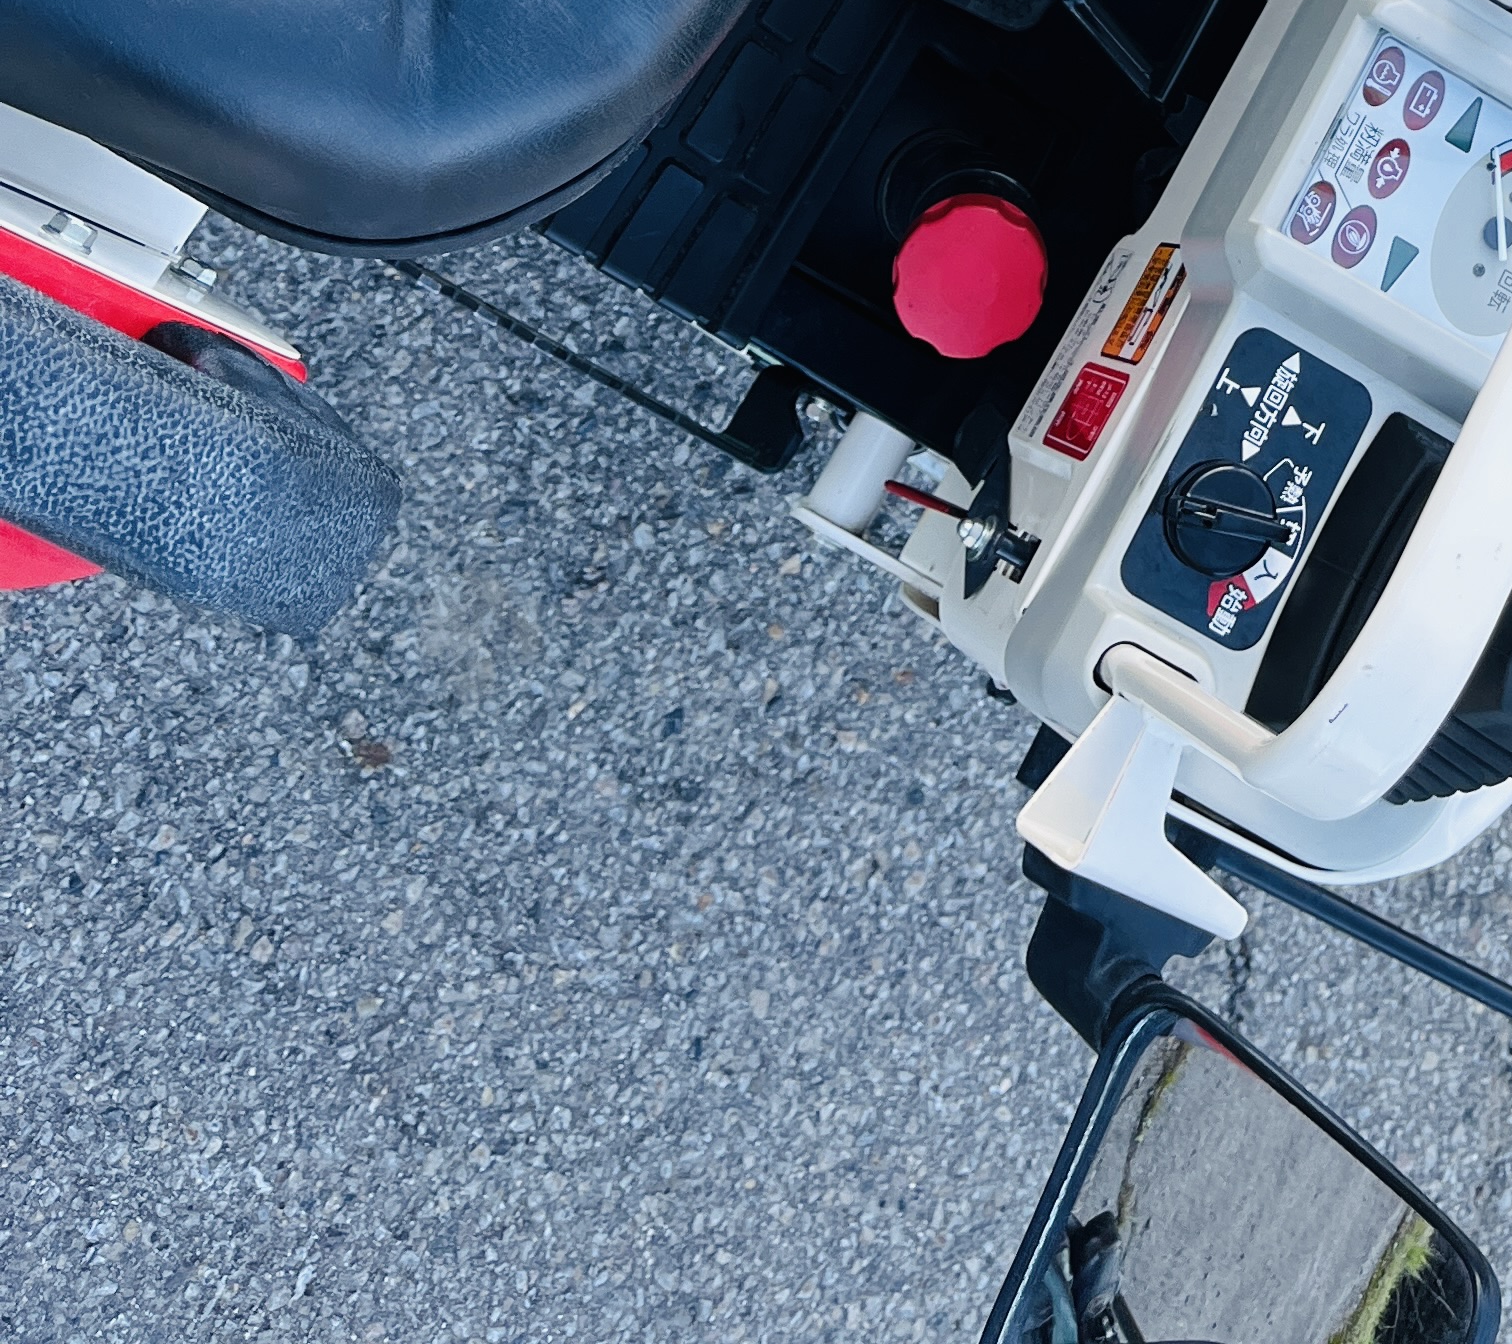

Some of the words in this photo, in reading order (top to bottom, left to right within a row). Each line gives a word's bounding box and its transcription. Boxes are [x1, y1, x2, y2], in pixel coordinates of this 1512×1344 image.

[1322, 109, 1361, 169] ワラ処理
[1339, 120, 1385, 185] 籾満量
[1214, 366, 1244, 397] 上
[1240, 365, 1299, 448] 旋回方向
[1296, 414, 1326, 445] 下
[1277, 461, 1314, 508] 予熱
[1253, 558, 1281, 588] 入
[1207, 581, 1252, 638] 始動
